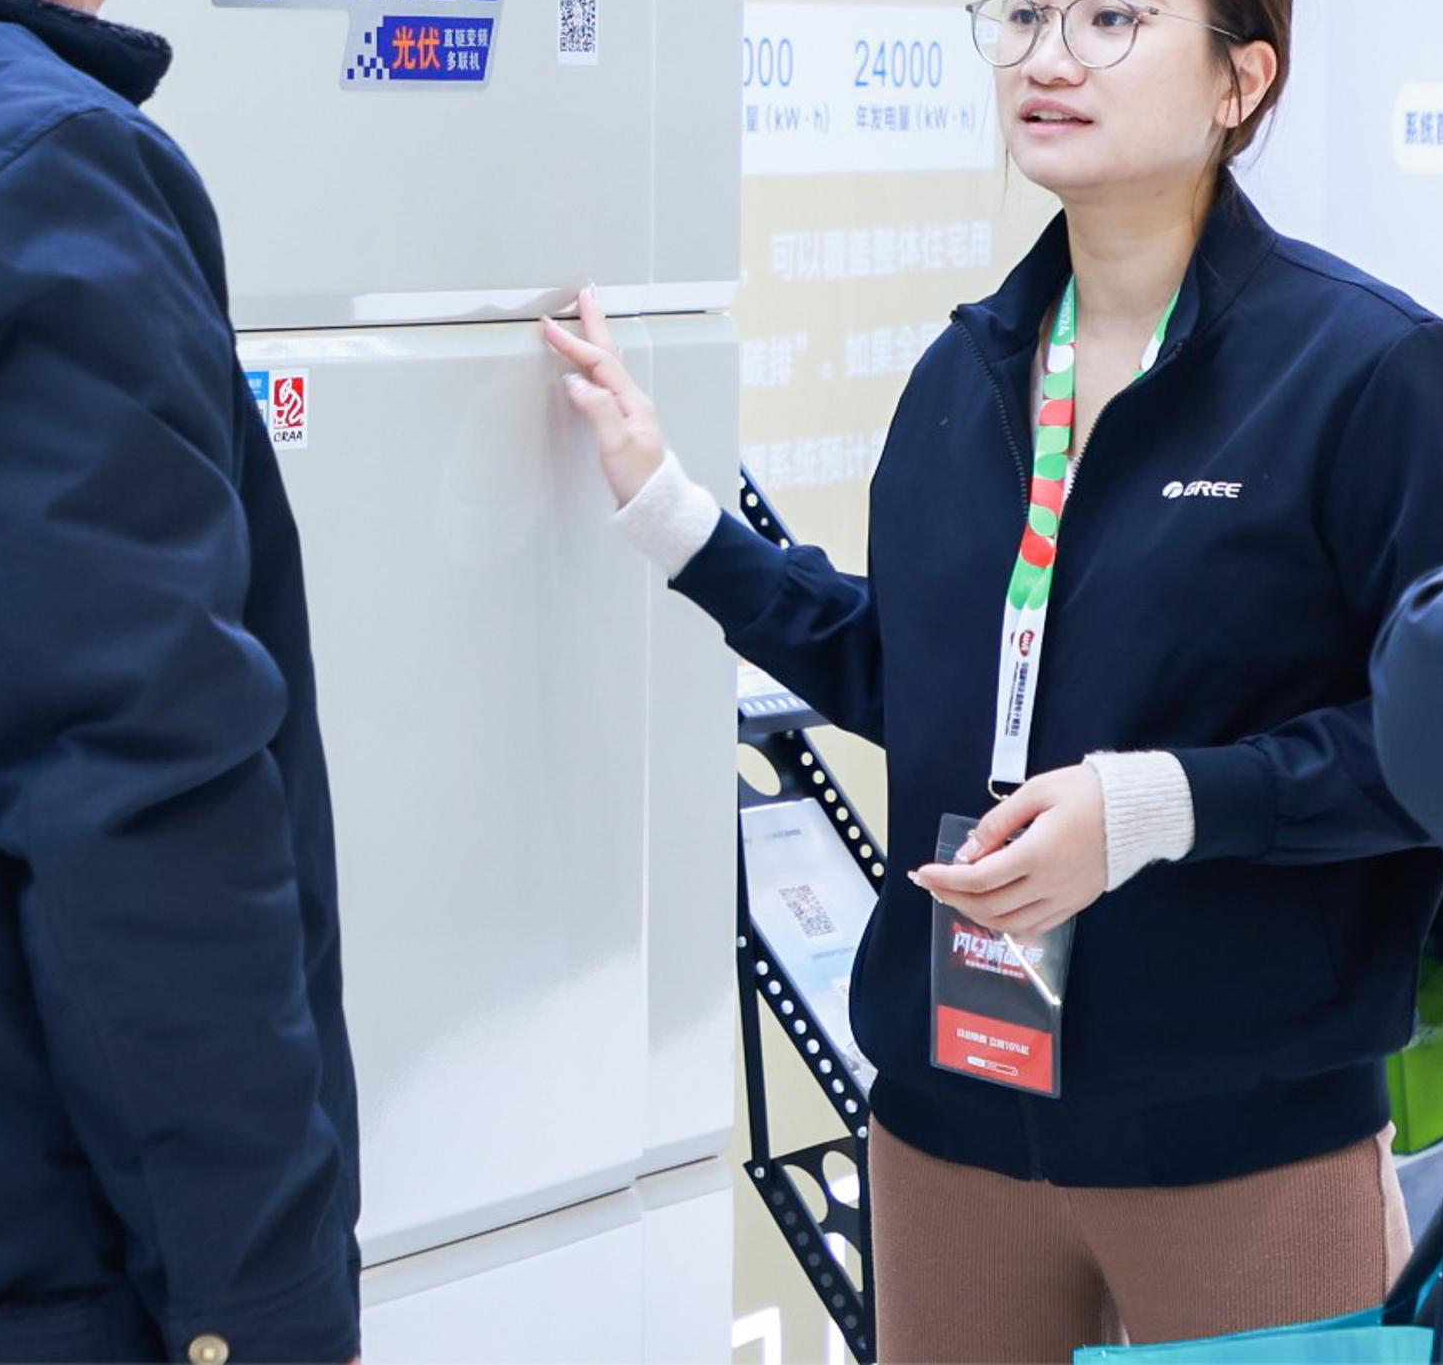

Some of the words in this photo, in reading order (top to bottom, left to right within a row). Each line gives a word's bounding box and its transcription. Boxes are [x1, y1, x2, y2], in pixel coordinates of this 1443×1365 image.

[392, 25, 441, 70] 光伏
[443, 27, 489, 48] 直驱变频
[447, 51, 480, 71] 多联机
[853, 39, 944, 88] 24000
[1183, 480, 1243, 499] GREE
